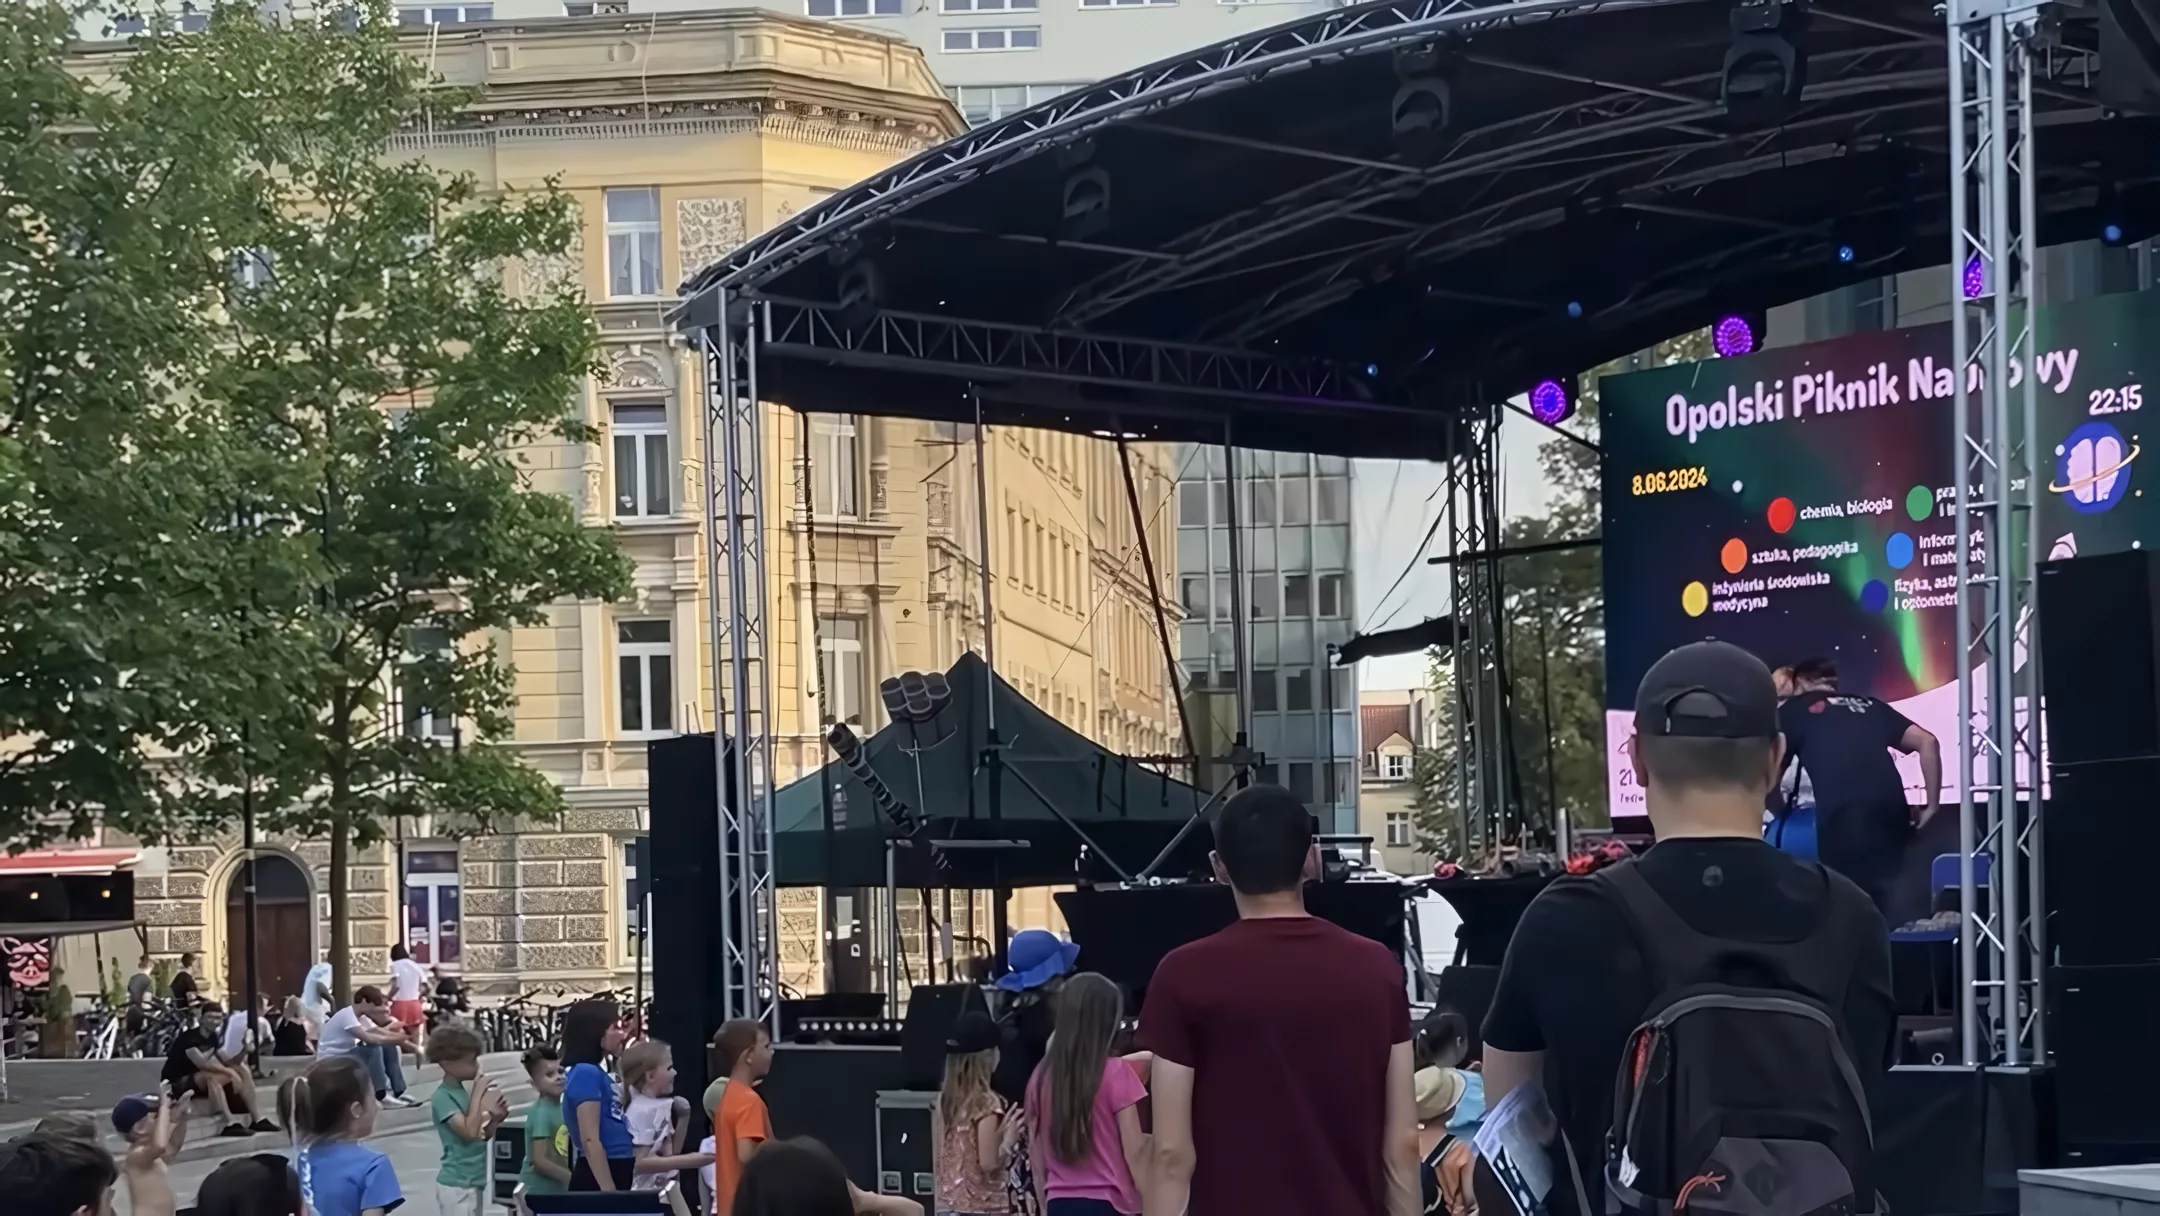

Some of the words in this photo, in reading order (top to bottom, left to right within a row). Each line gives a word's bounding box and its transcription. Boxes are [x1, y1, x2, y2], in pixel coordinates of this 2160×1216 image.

[1665, 379, 1784, 444] Opolski
[1792, 361, 1901, 418] Piknik
[2088, 384, 2143, 416] 22:15
[1631, 465, 1708, 496] 8.06.2024
[1846, 496, 1893, 515] biologia
[1792, 541, 1859, 563] pedagogika
